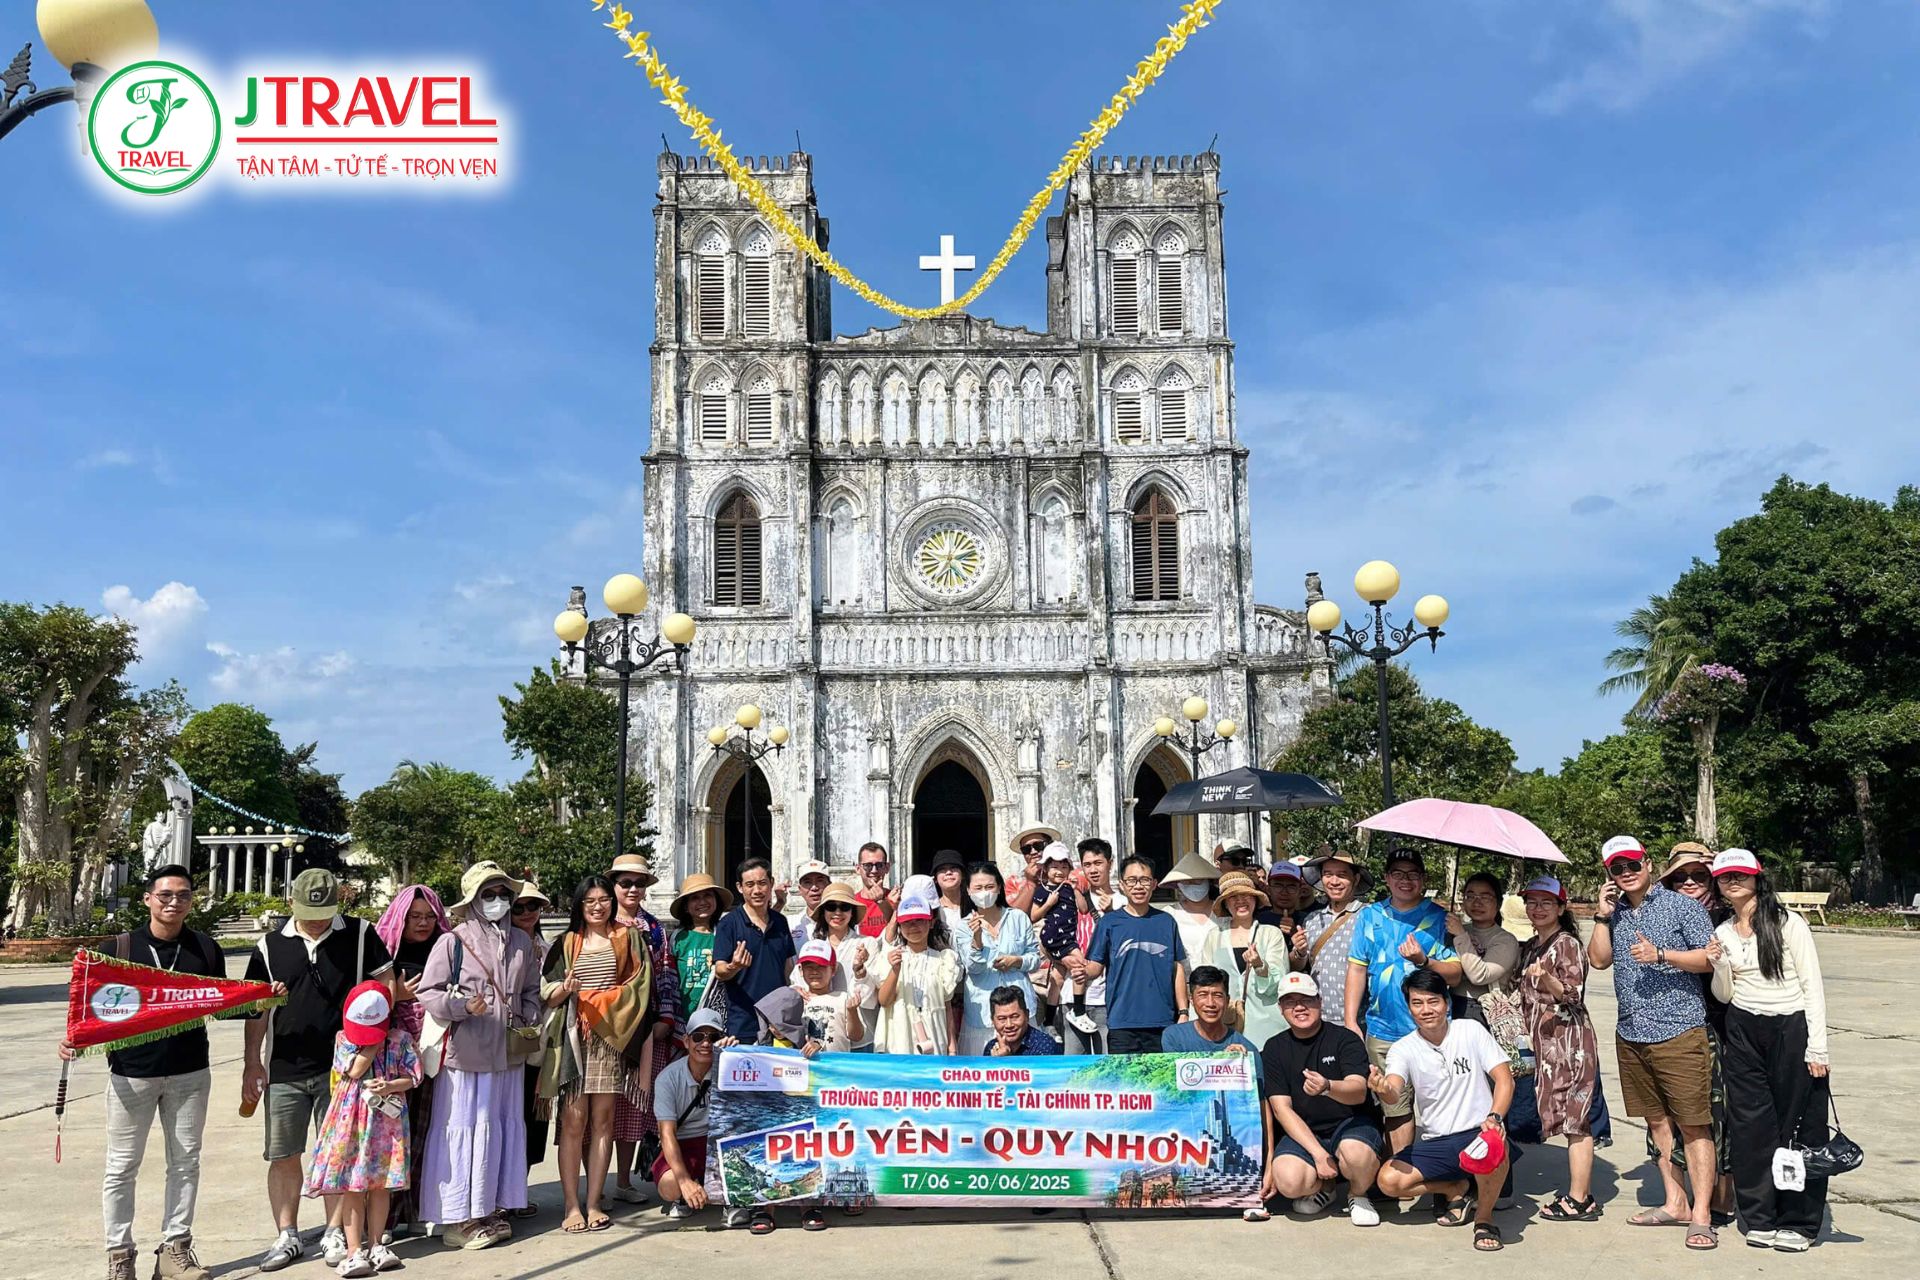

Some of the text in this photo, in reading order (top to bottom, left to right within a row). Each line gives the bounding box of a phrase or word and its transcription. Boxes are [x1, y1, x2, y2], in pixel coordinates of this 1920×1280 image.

[1203, 785, 1232, 794] THINK
[1202, 793, 1224, 802] NEW
[162, 987, 224, 1002] TRAVEL
[732, 1070, 761, 1082] UEF
[820, 1087, 878, 1107] TRƯỜNG
[883, 1091, 907, 1110] ĐẠI
[912, 1091, 942, 1111] HỌC
[947, 1092, 982, 1108] KINH
[986, 1087, 1004, 1108] TẾ
[1018, 1090, 1040, 1109] TÀI
[1045, 1089, 1090, 1110] CHÍNH
[1095, 1094, 1115, 1110] TP.
[1120, 1094, 1152, 1110] HCM
[768, 1122, 854, 1161] PHÚ
[867, 1120, 949, 1155] YÊN
[984, 1128, 1074, 1162] QUY
[1085, 1132, 1209, 1166] NHƠN
[902, 1172, 949, 1190] 17/06
[968, 1173, 1070, 1191] 20/06/2025
